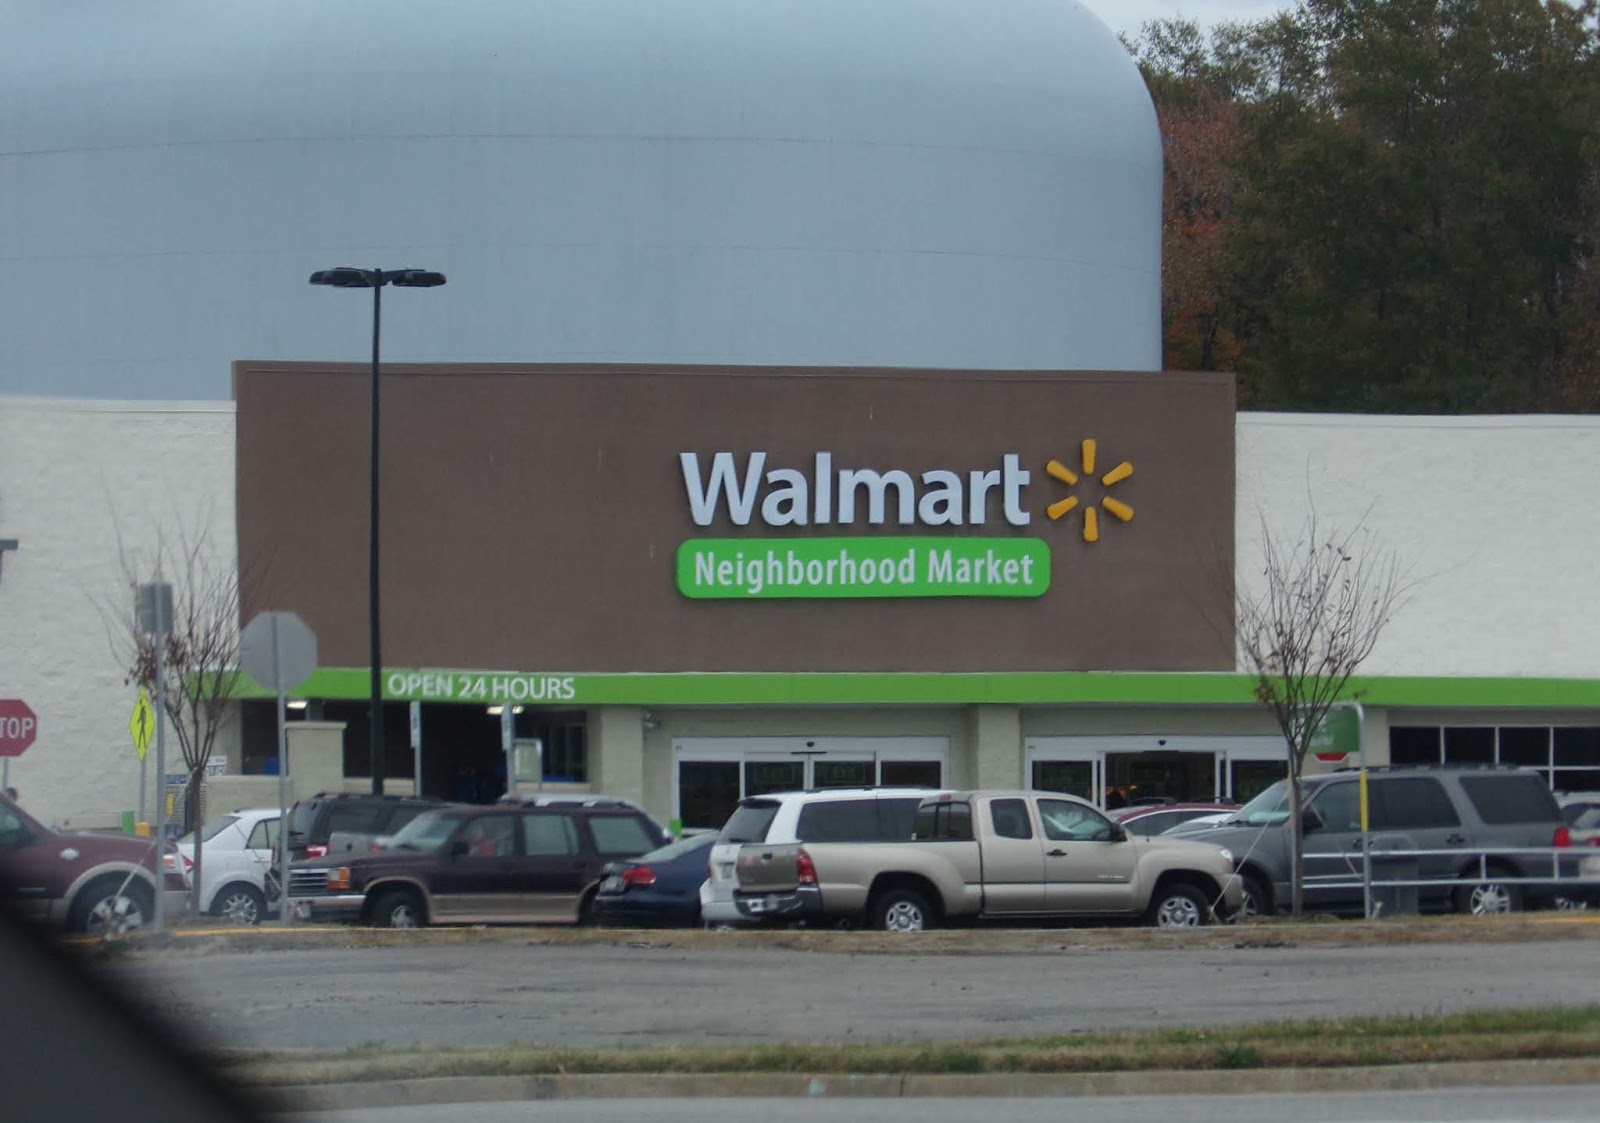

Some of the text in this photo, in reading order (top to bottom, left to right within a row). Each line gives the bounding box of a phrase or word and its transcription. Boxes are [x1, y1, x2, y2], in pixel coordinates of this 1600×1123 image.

[679, 451, 1031, 526] Walmart
[694, 548, 1034, 594] Neighborhood Market
[387, 672, 576, 700] OPEN 24 HOURS
[0, 716, 34, 740] TOP
